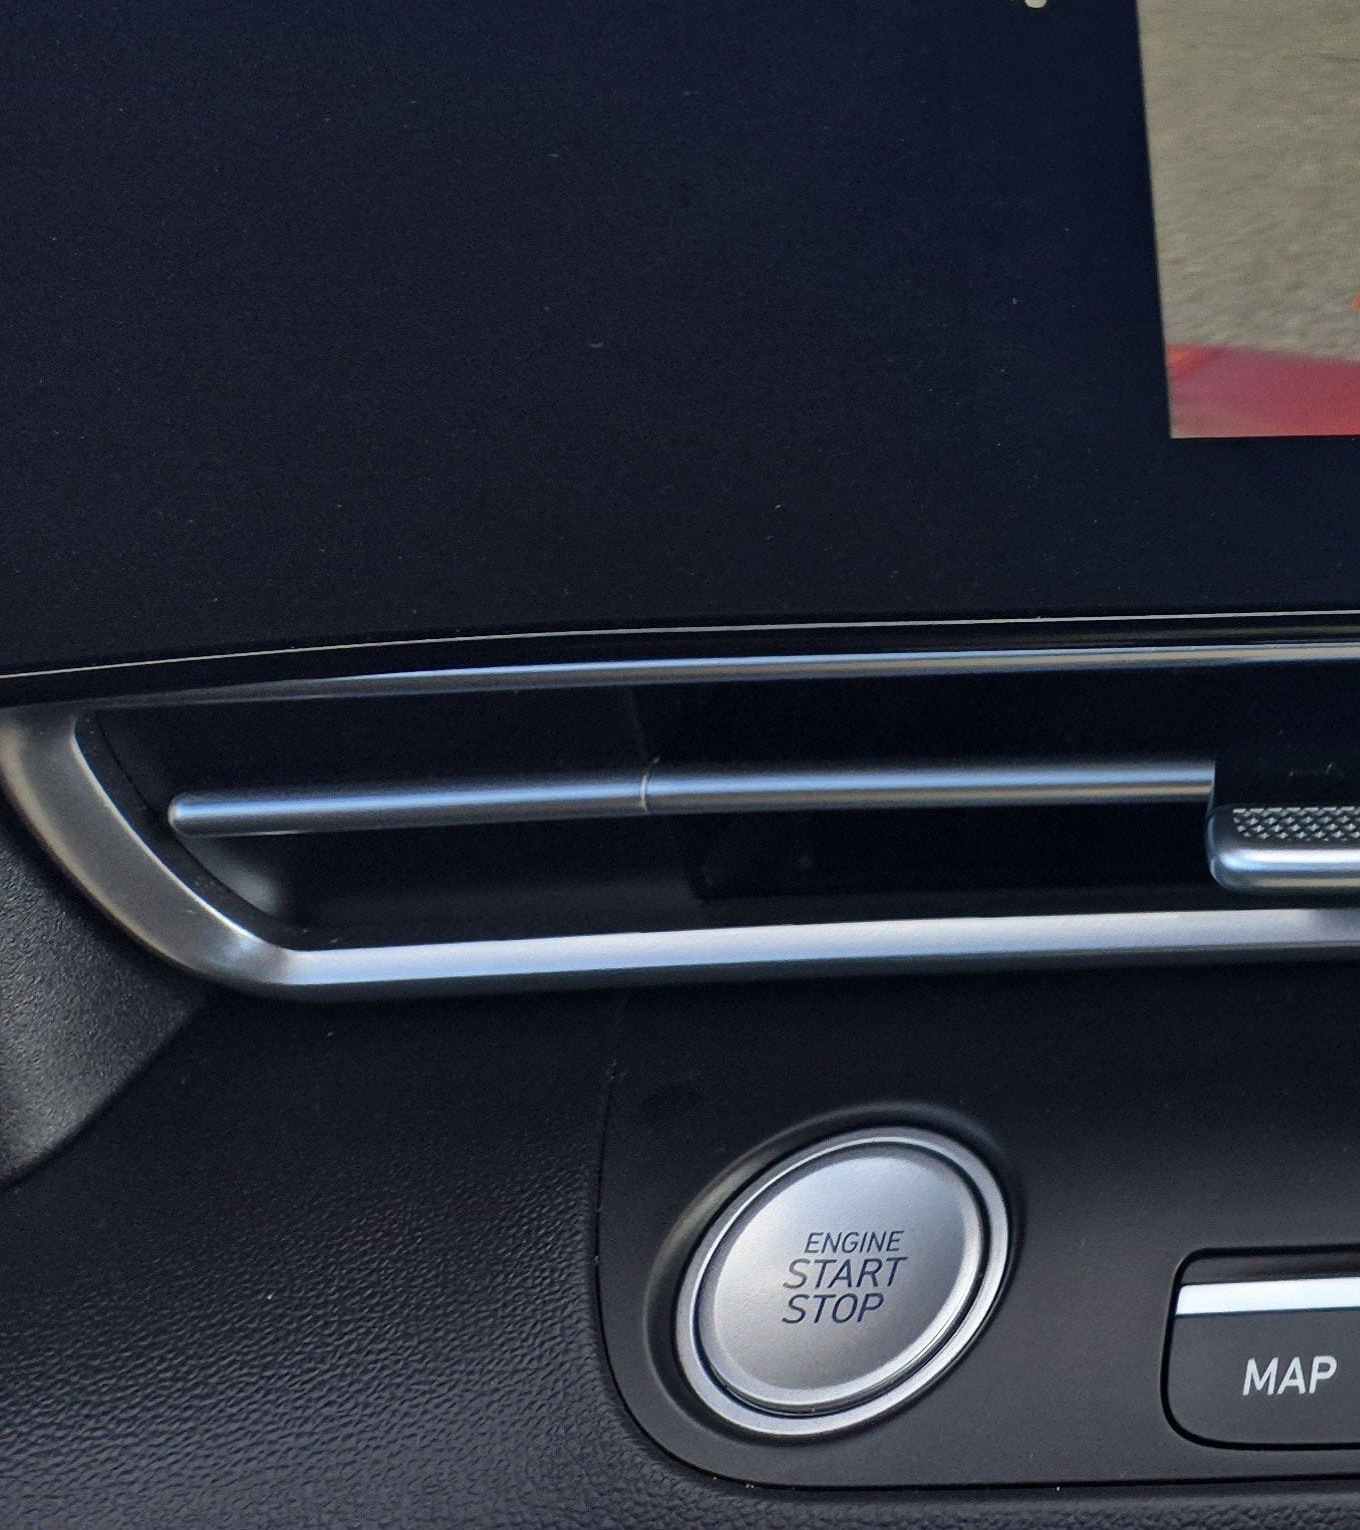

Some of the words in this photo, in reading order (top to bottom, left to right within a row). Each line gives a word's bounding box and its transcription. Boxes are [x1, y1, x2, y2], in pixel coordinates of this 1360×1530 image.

[804, 1230, 905, 1254] ENGINE
[782, 1256, 908, 1290] START
[781, 1292, 885, 1324] STOP
[1241, 1354, 1339, 1398] MAP
